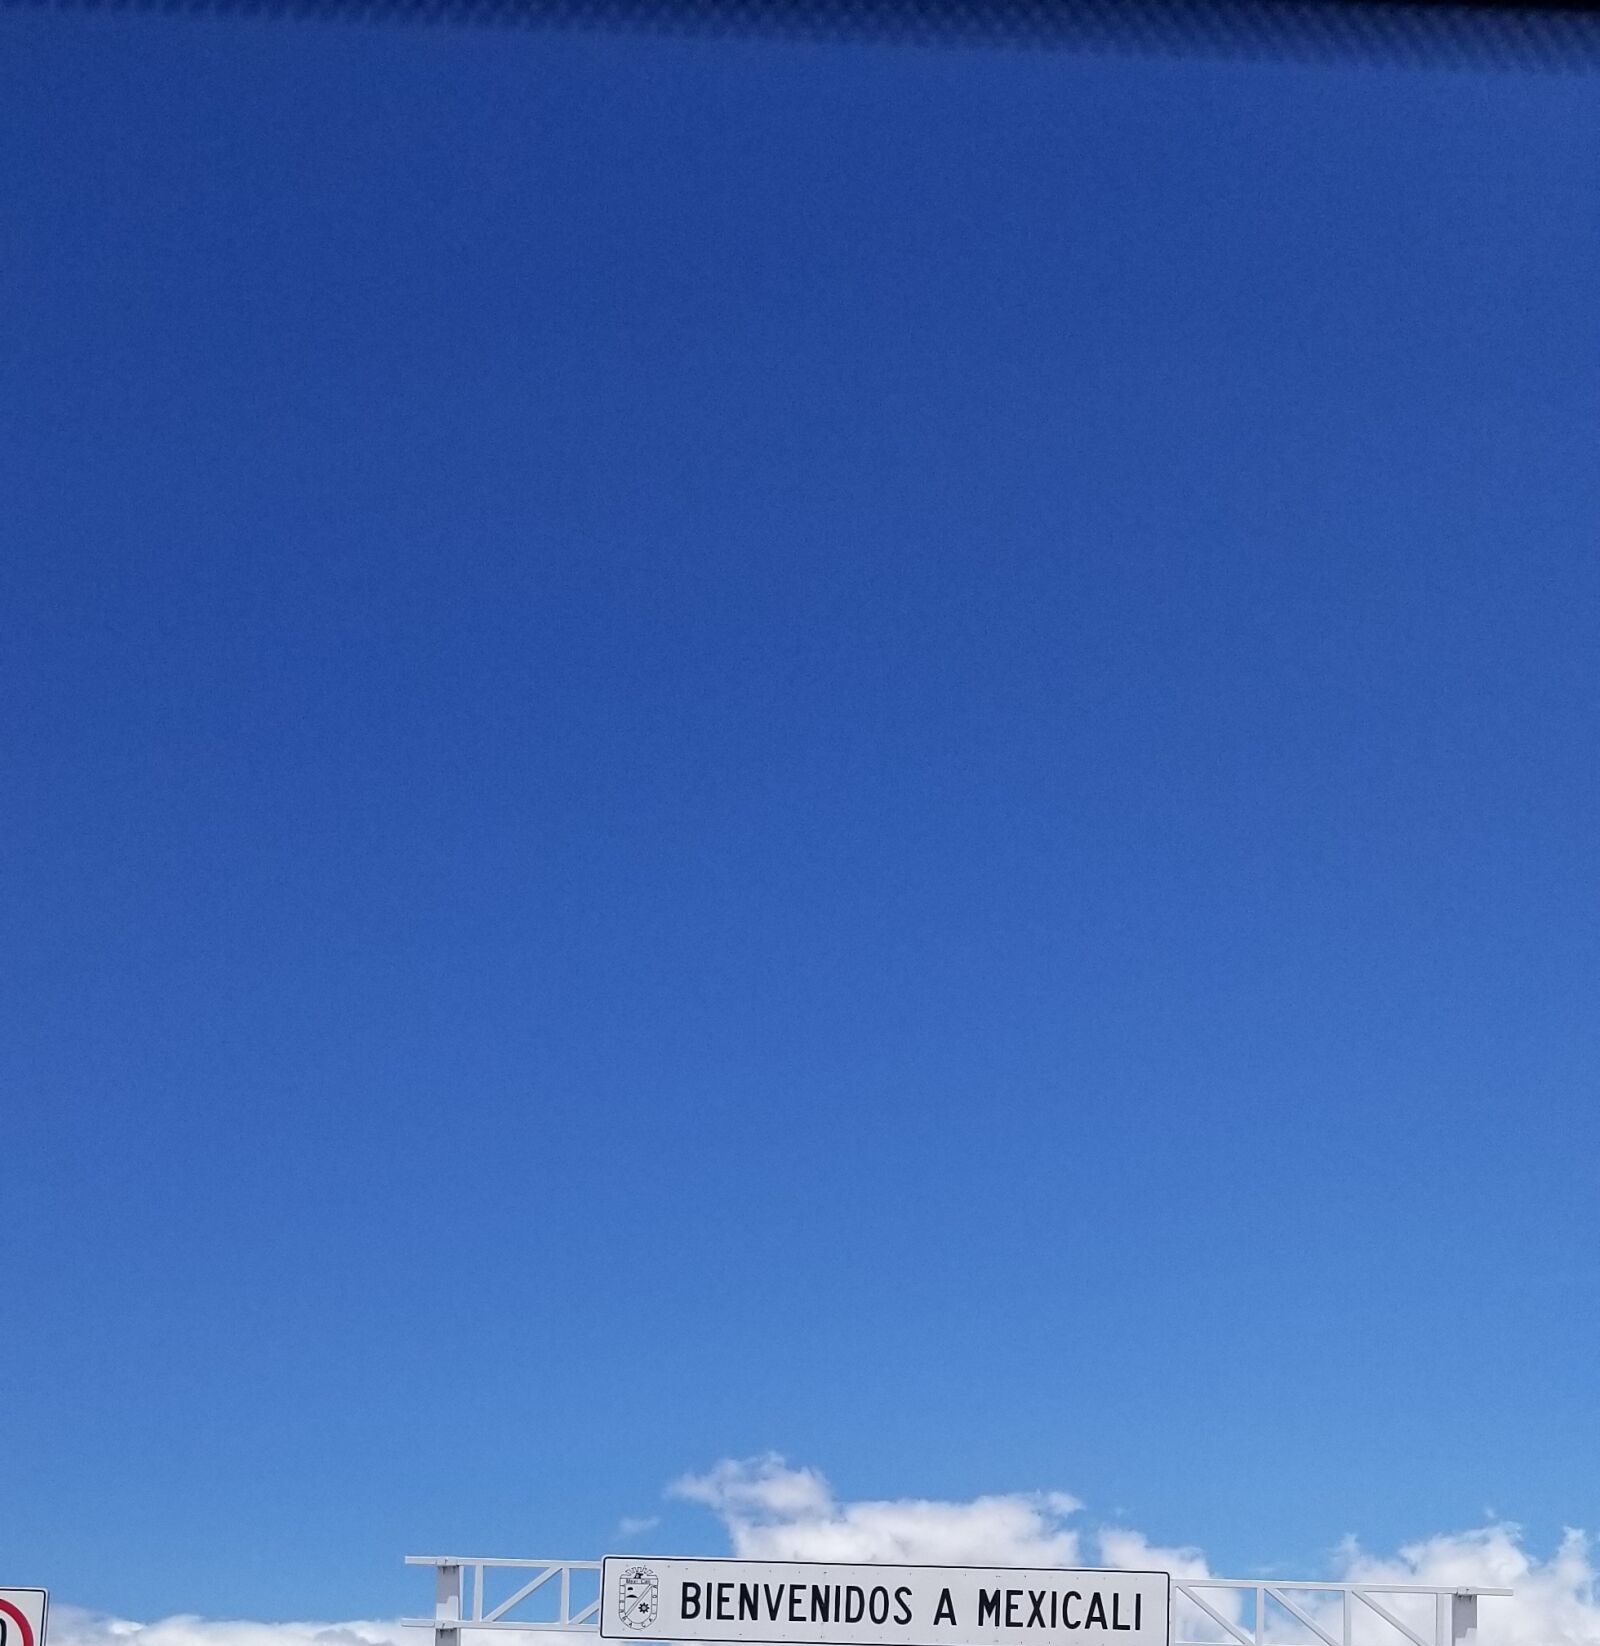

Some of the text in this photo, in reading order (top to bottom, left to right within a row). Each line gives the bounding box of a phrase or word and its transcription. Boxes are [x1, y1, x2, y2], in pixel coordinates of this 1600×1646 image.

[681, 1582, 1141, 1630] BIENVENIDOS A MEXICALI
